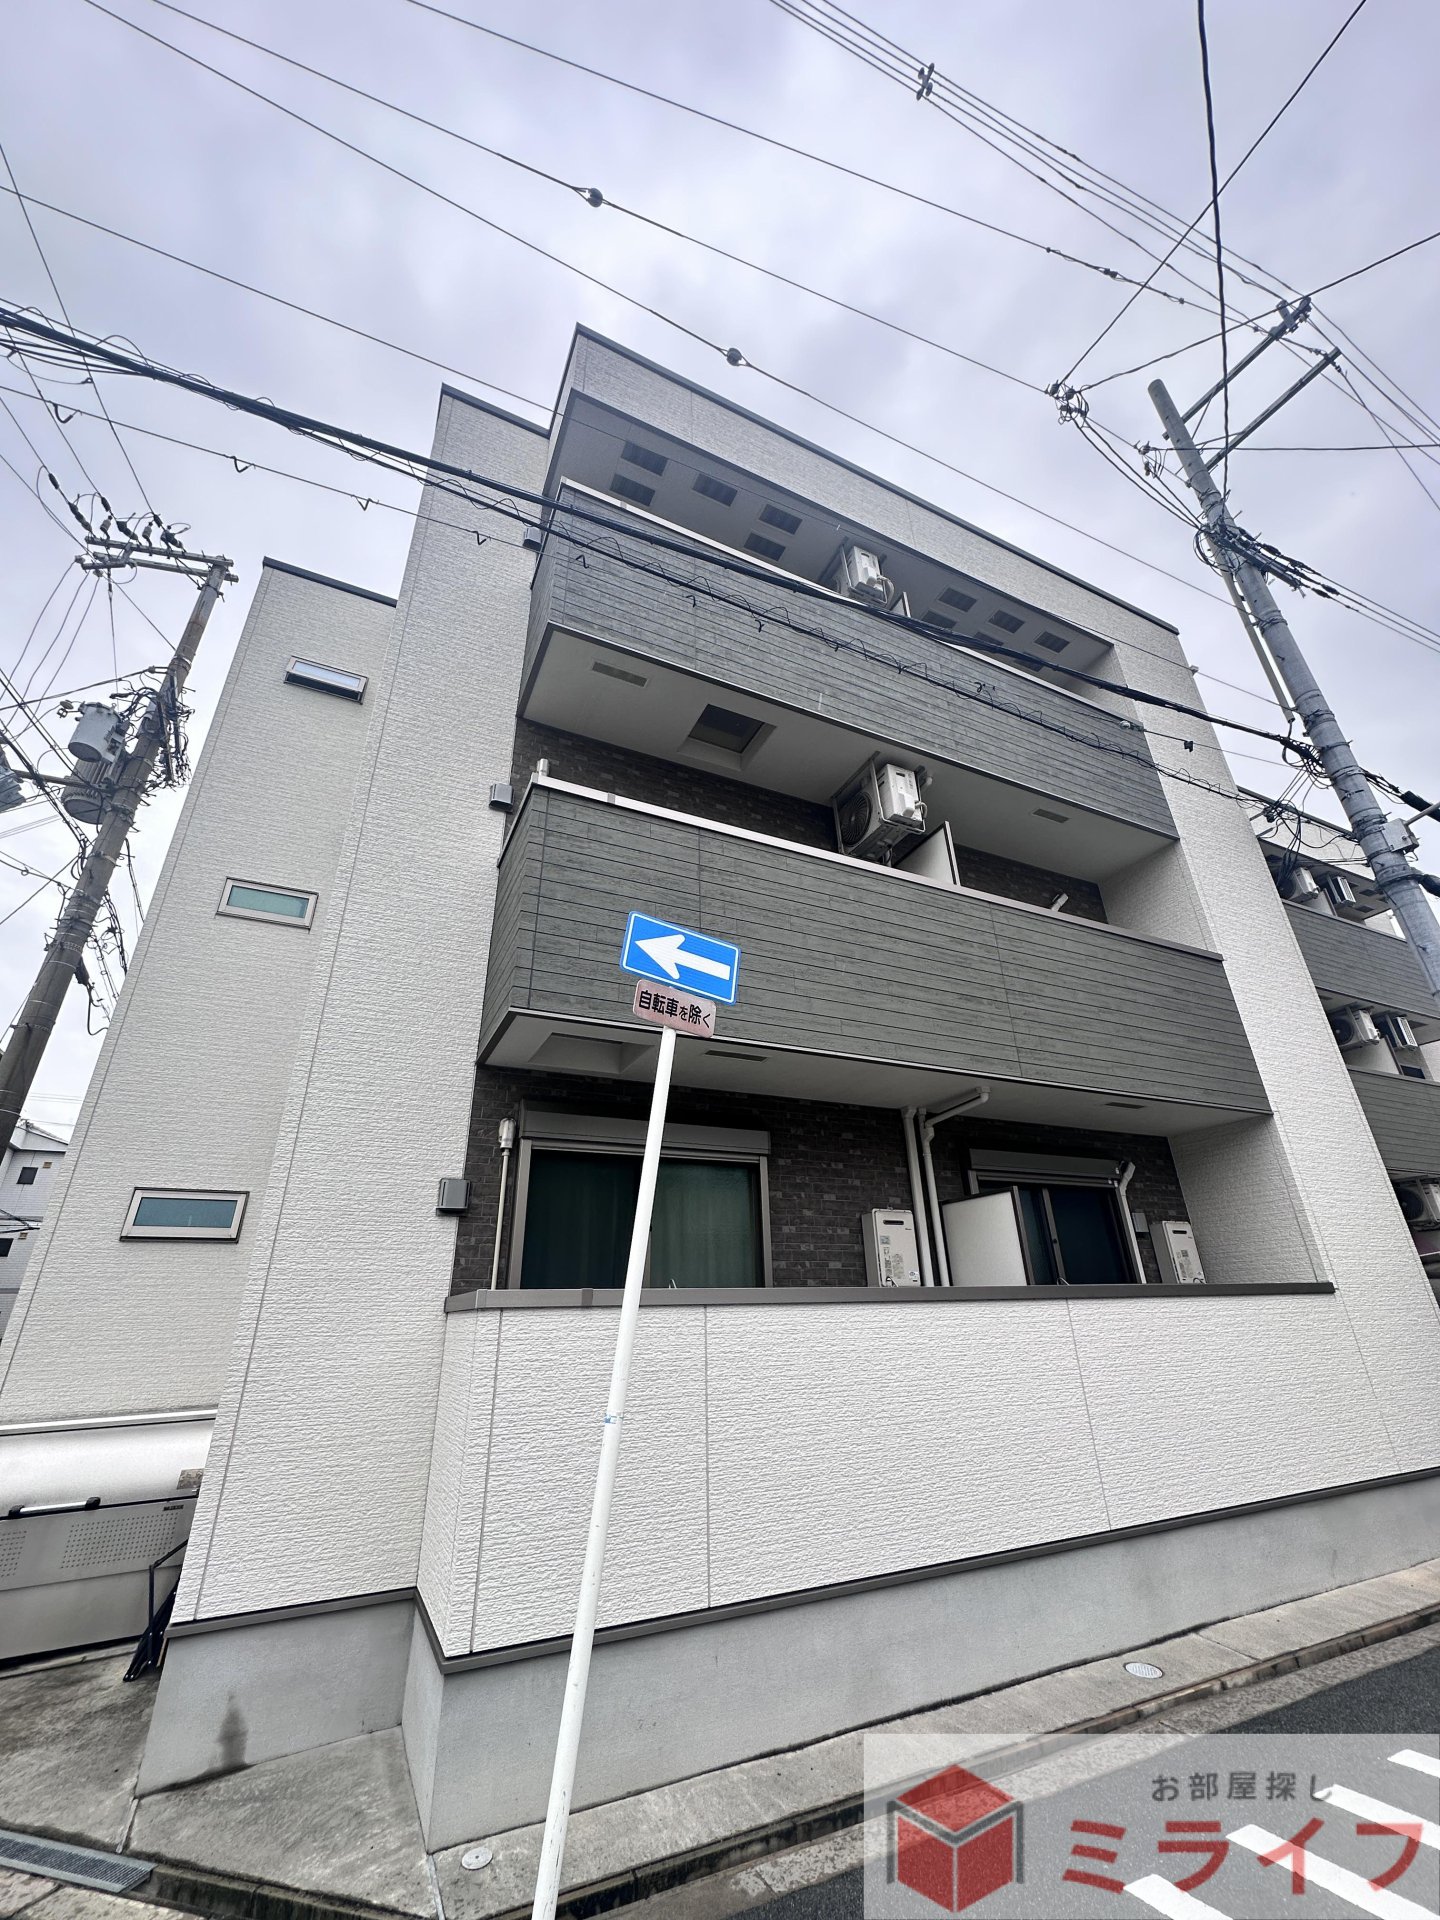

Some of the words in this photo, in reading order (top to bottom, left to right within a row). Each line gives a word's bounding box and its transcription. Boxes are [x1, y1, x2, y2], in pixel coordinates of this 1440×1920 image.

[638, 989, 711, 1028] 自転車を除く
